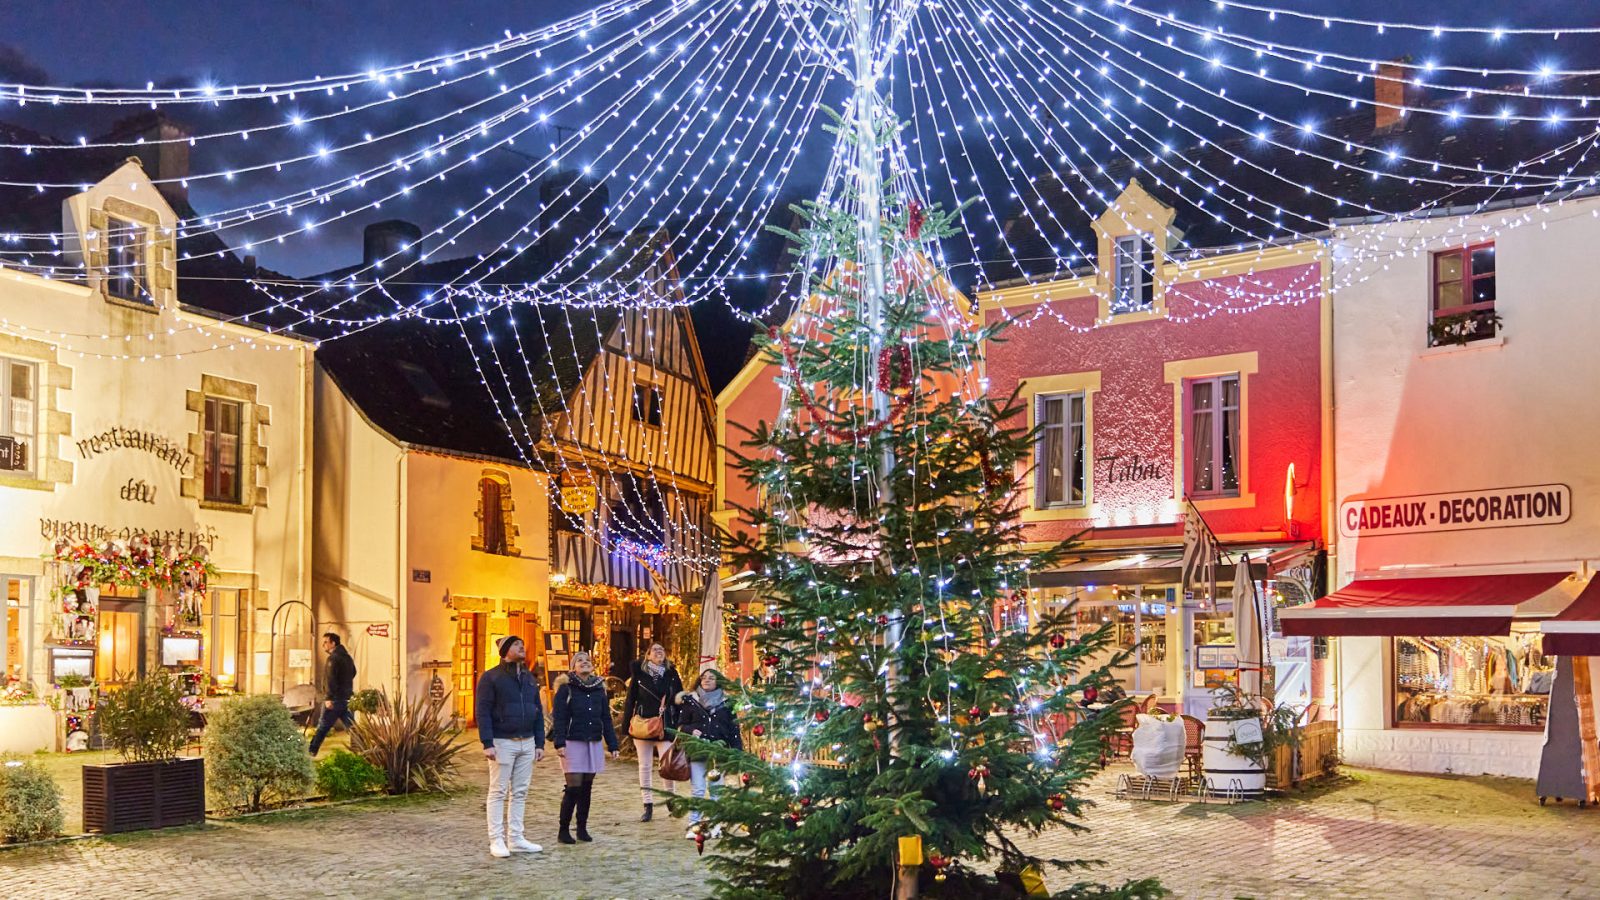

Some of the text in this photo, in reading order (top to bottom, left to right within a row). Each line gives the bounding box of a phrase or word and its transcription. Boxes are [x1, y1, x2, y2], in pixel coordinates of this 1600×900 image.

[1098, 455, 1166, 483] Tabac
[121, 478, 151, 504] du
[1346, 491, 1562, 531] CADEAUX DECORATION
